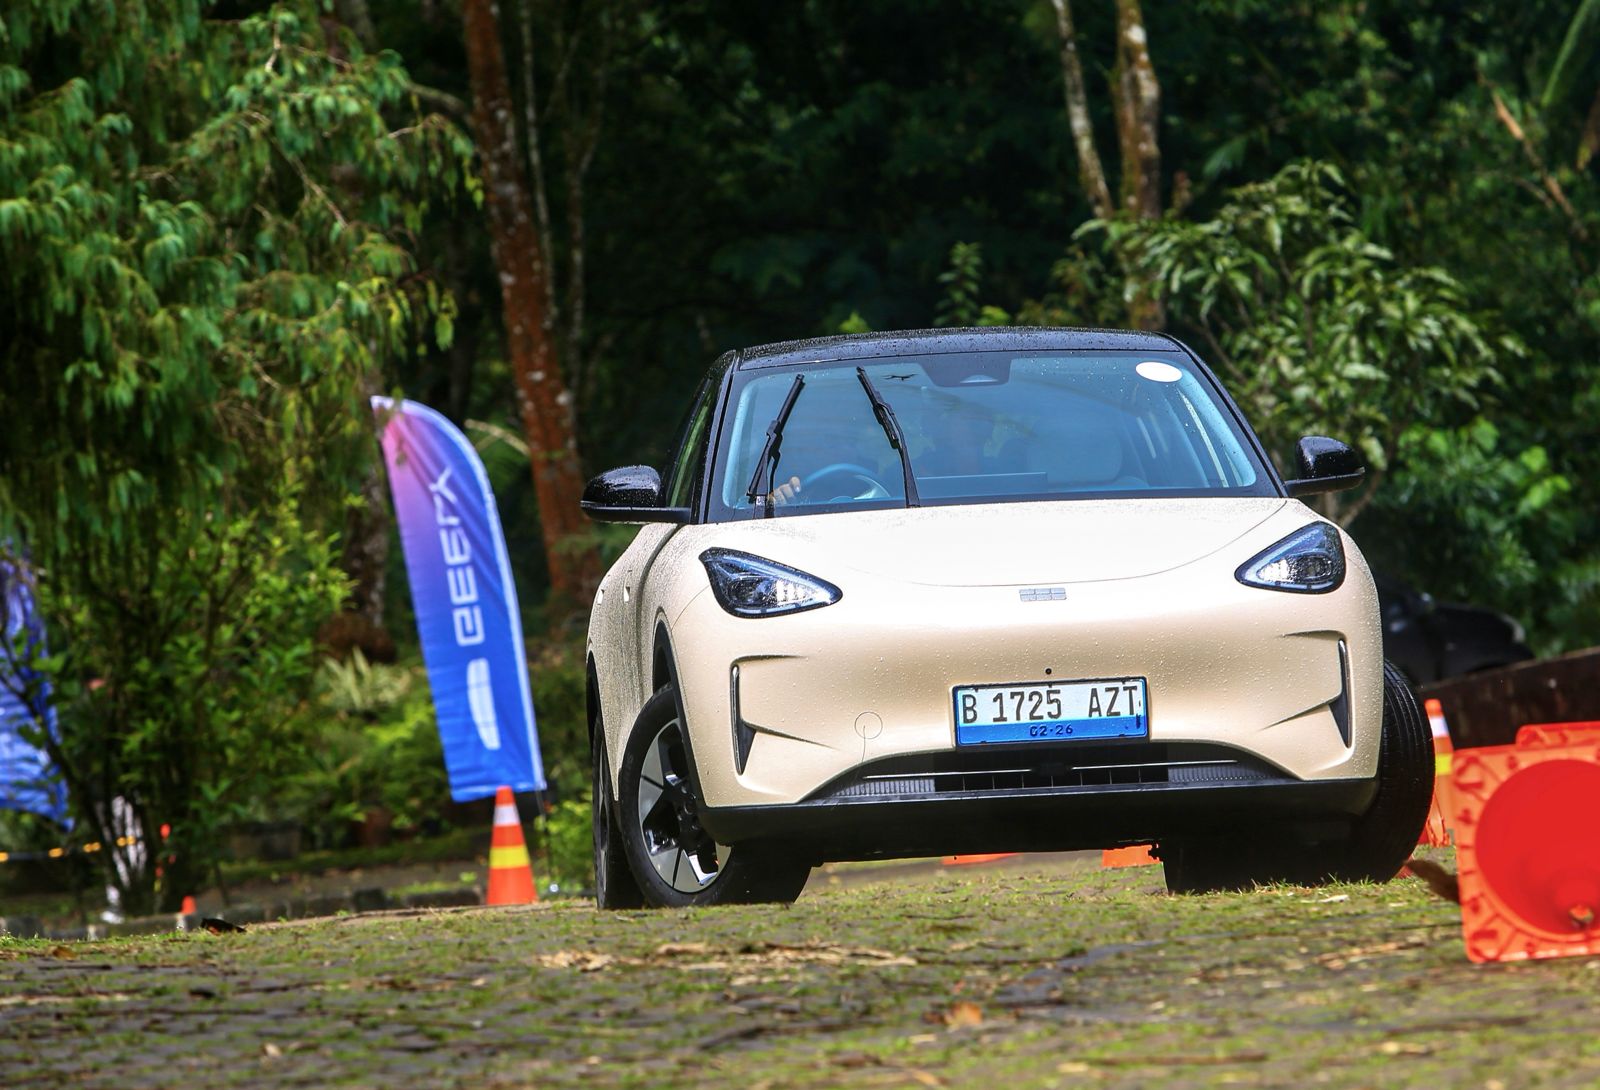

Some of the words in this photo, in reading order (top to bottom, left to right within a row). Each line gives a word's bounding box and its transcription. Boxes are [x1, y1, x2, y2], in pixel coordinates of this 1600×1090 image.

[430, 468, 485, 646] GEELY
[962, 694, 977, 724] B
[992, 689, 1062, 723] 1725
[1088, 685, 1137, 718] AZT
